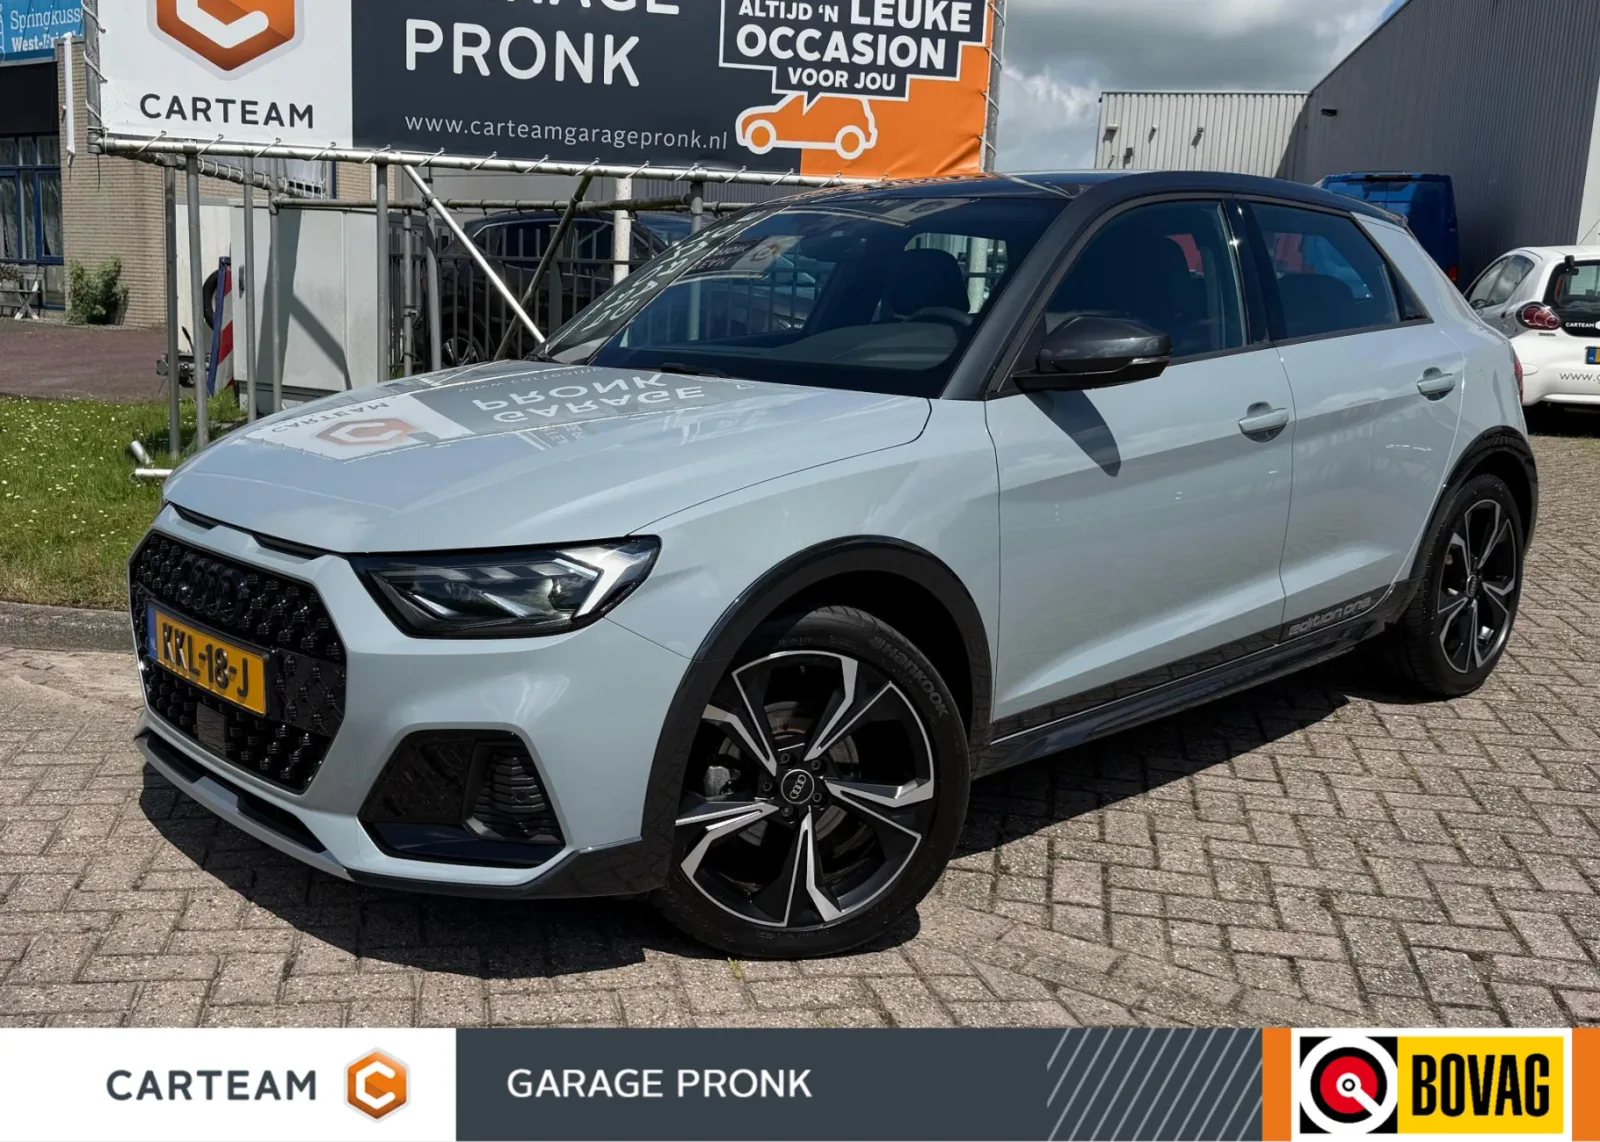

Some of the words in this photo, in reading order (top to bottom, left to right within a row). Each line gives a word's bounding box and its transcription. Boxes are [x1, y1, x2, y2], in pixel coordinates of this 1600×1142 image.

[10, 5, 84, 33] Springkuss
[738, 0, 813, 21] ALTIJD
[851, 0, 973, 33] LEUKE
[405, 18, 640, 87] PRONK
[736, 24, 947, 70] OCCASION
[788, 67, 849, 88] VOOR
[853, 71, 897, 91] JOU
[139, 92, 314, 129] CARTEAM
[404, 115, 728, 151] www.carteamgaragepronk.nl
[1288, 607, 1343, 637] edition
[1343, 596, 1372, 616] one
[162, 621, 250, 698] KKL-18-J
